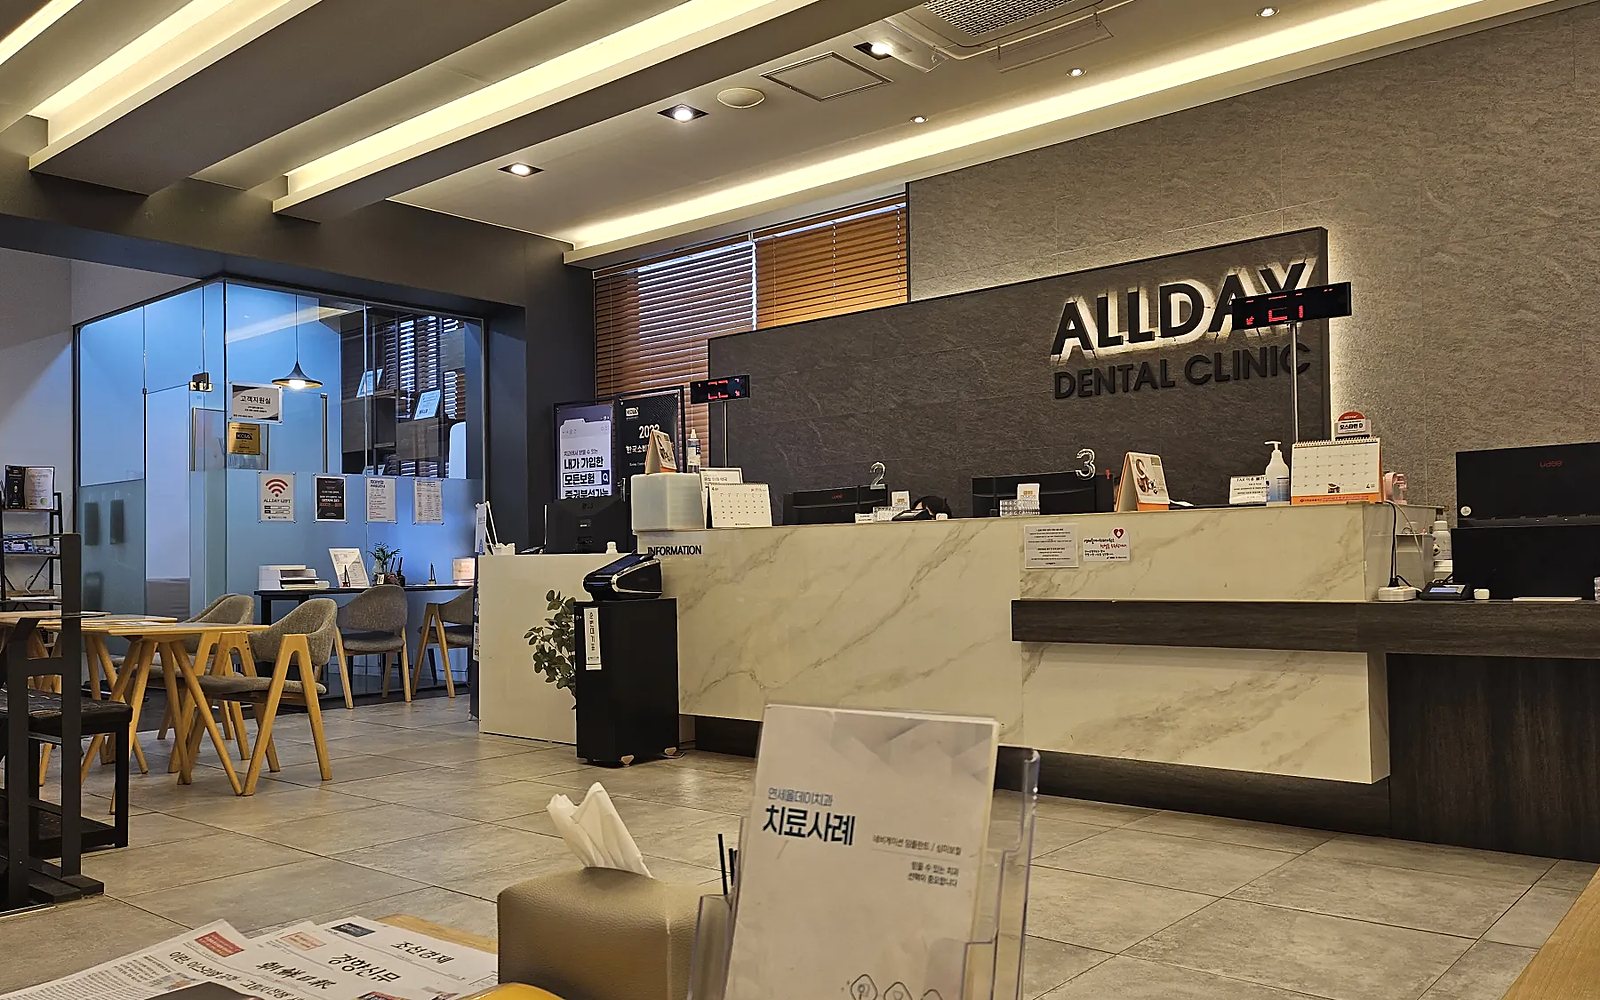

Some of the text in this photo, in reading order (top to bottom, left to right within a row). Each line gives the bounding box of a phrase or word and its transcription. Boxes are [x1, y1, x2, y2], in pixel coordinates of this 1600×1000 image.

[1051, 262, 1308, 356] ALLDAY
[1054, 342, 1312, 400] DENTAL CLINIC
[240, 395, 271, 405] 고객지원실
[563, 456, 604, 470] 내가 가입한
[1075, 448, 1096, 481] 3
[564, 473, 595, 486] 모든보험
[869, 461, 887, 490] 2
[647, 545, 702, 556] INFORMATION
[767, 786, 834, 807] 연세올데이치과
[762, 804, 856, 846] 치료사례
[904, 839, 930, 851] 임플란트
[925, 863, 932, 872] 수
[933, 864, 945, 875] 있는
[947, 867, 960, 877] 치과
[927, 875, 959, 888] 중요합니다
[390, 940, 455, 965] 조선경제
[328, 953, 402, 984] 경향신문
